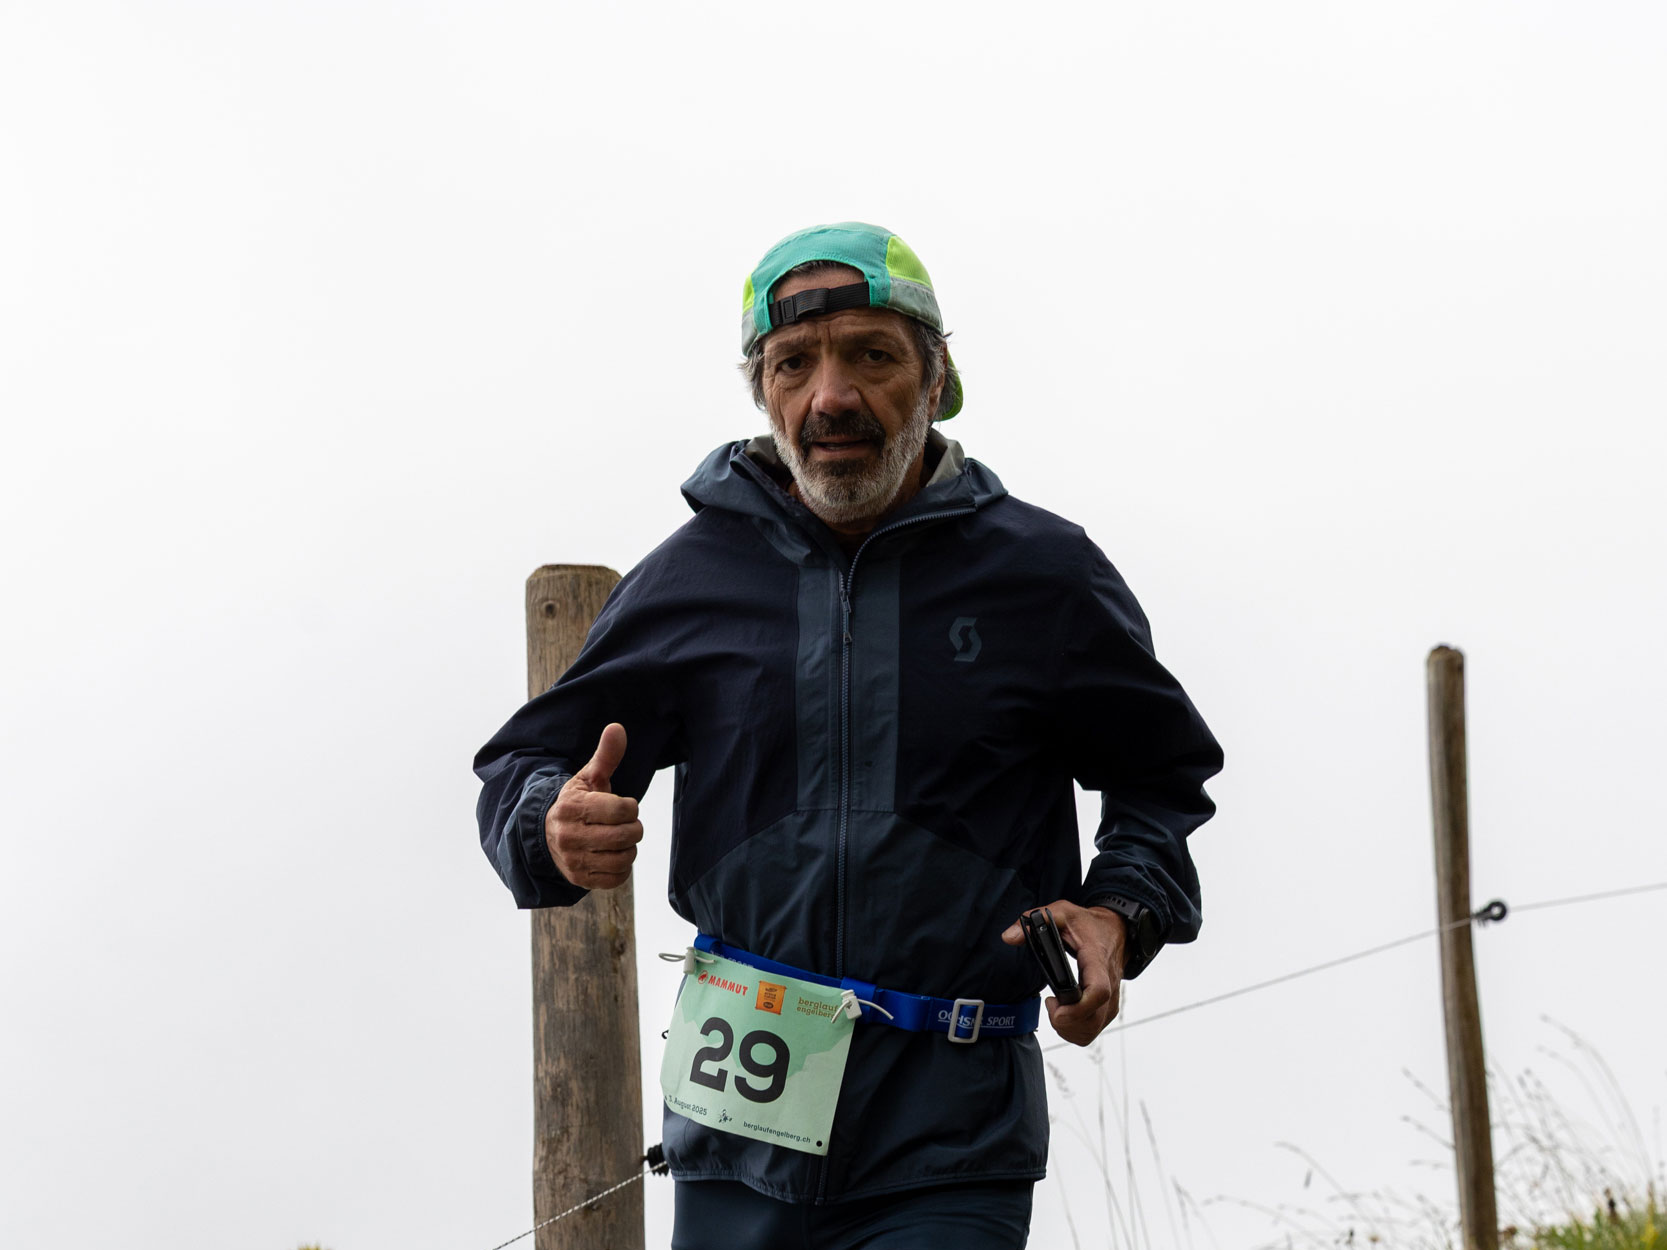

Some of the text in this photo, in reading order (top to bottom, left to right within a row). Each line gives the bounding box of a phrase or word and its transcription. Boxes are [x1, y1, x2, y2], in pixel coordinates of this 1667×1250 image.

[708, 975, 748, 996] MAMMUT
[798, 996, 838, 1012] berglauf
[986, 1016, 1016, 1026] SPORT
[690, 1017, 790, 1103] 29
[673, 1097, 692, 1110] August
[691, 1104, 708, 1116] 2025
[743, 1121, 811, 1143] berglaufengelberg.ch
